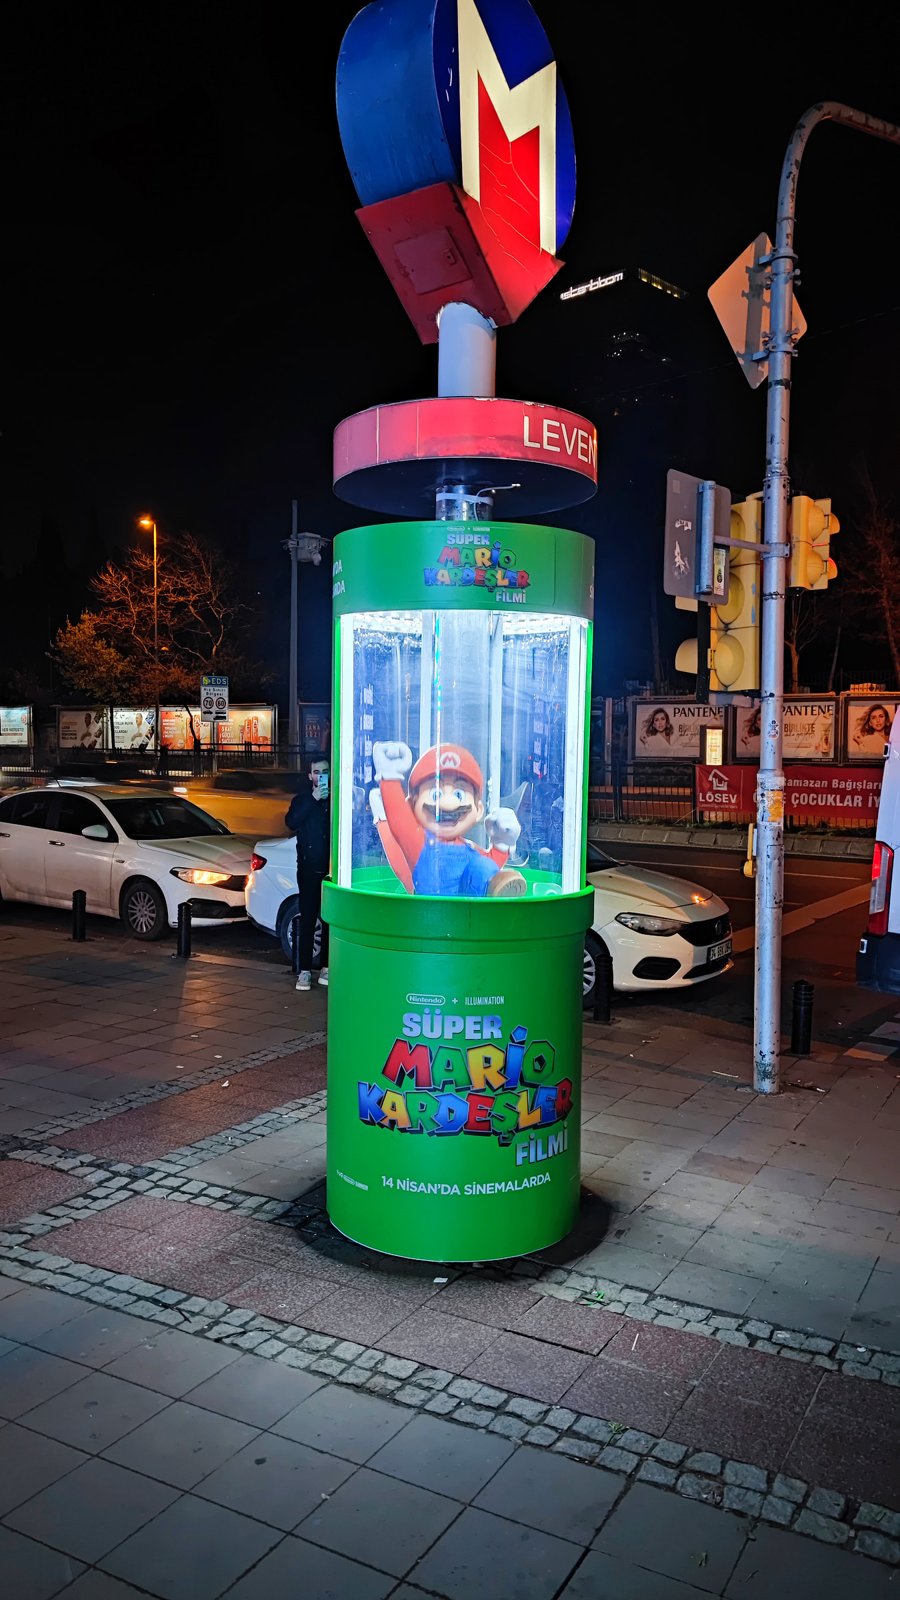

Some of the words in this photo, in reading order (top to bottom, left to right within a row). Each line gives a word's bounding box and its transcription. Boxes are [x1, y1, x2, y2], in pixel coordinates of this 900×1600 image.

[446, 531, 490, 545] SÜPER
[211, 677, 227, 685] EDS
[673, 706, 724, 717] PANTENE
[699, 791, 737, 803] LÖSEV
[791, 793, 863, 808] ÇOCUKLAR
[409, 995, 442, 1004] Nintendo
[464, 996, 505, 1006] ILLUMINATION
[402, 1008, 502, 1040] SÜPER
[357, 1077, 574, 1147] KARDEŞLER
[515, 1121, 569, 1166] FİLMİ
[381, 1175, 394, 1189] 14
[396, 1178, 461, 1196] NİSAN'DA
[464, 1172, 551, 1196] SİNEMALARDA
